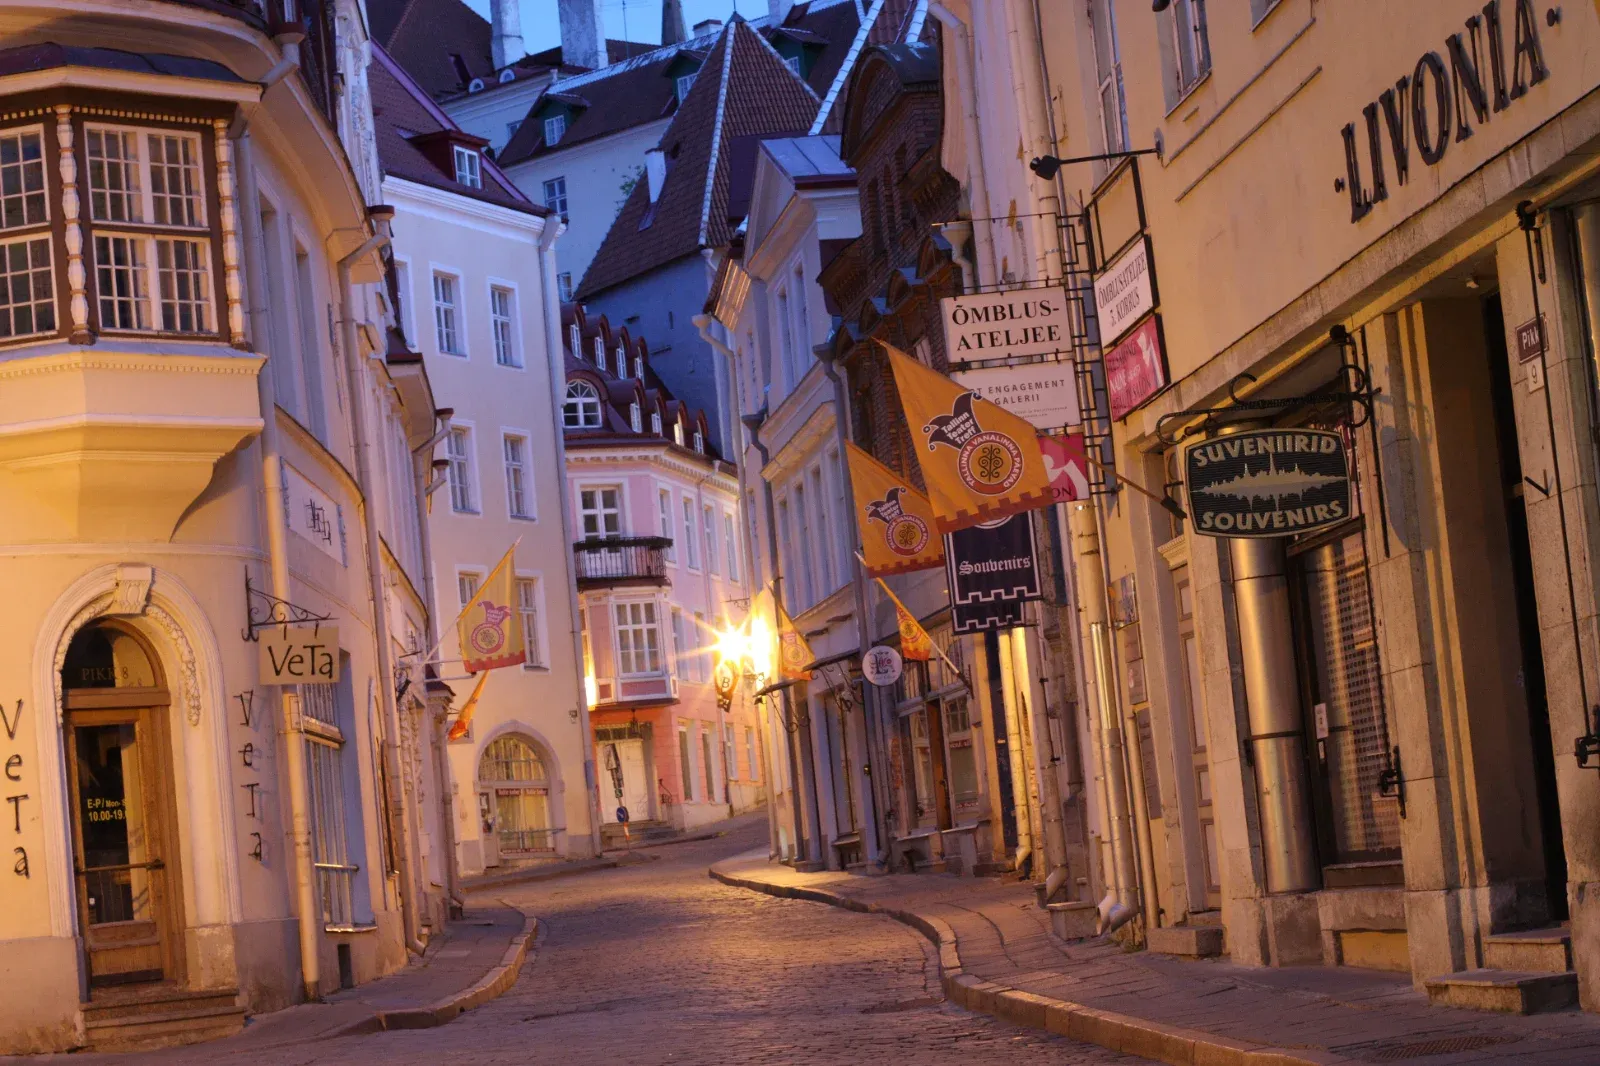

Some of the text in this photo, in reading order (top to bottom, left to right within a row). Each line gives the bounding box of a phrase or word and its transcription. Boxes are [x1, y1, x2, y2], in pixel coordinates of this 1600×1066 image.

[1340, 0, 1546, 223] LIVONIA
[951, 300, 1060, 325] ÕMBLUS-
[956, 324, 1061, 351] ATELJEE
[1521, 326, 1540, 350] Pikk
[1531, 364, 1538, 384] 9
[988, 379, 1066, 394] ENGAGEMENT
[994, 394, 1041, 406] GALERII
[940, 411, 970, 434] Tallinn
[947, 418, 974, 440] Teater
[955, 427, 977, 445] Treff
[961, 445, 976, 487] TALLINNA
[972, 434, 1018, 456] VANALINNA
[1193, 434, 1337, 467] SUVENIIRID
[1201, 500, 1343, 531] SOUVENIRS
[958, 555, 1031, 576] Souvenirs
[81, 666, 129, 681] PIKK 8
[267, 645, 334, 680] VeTa
